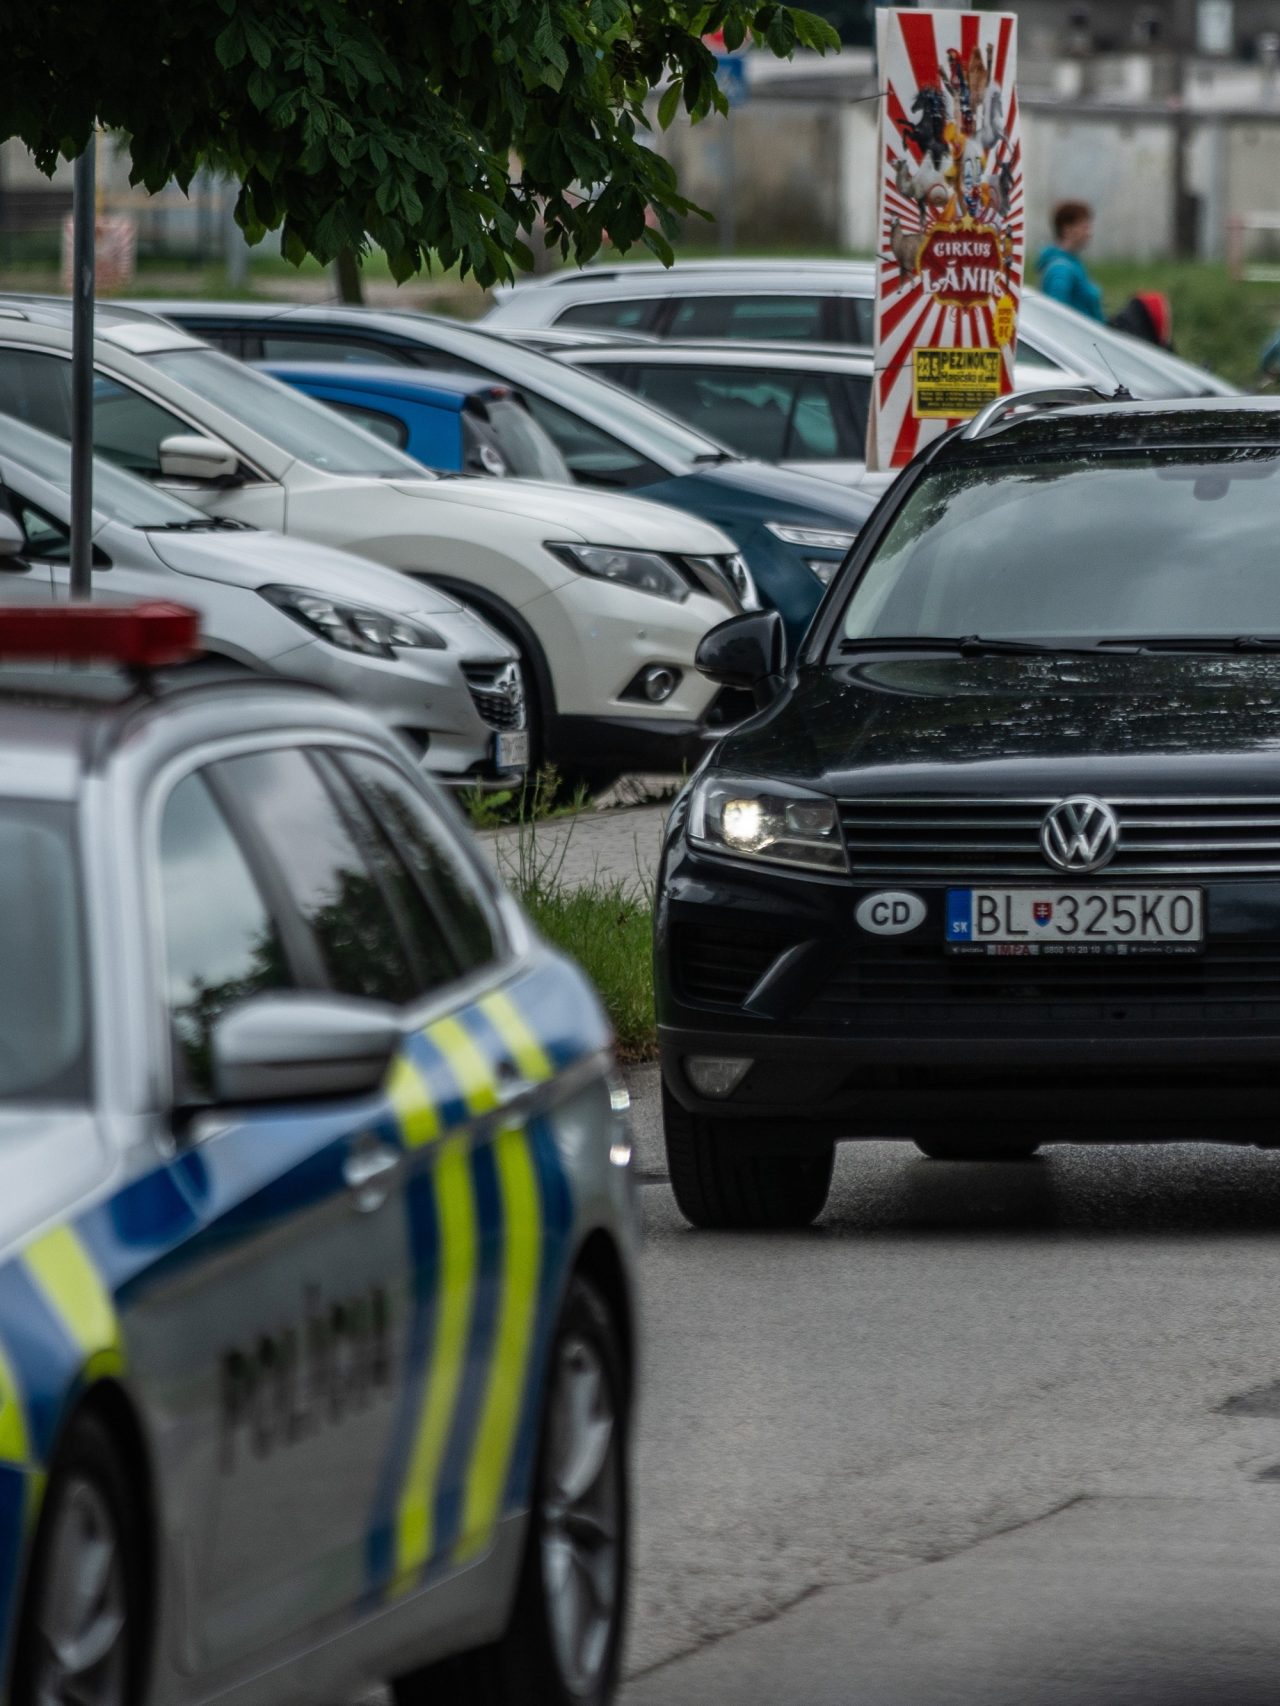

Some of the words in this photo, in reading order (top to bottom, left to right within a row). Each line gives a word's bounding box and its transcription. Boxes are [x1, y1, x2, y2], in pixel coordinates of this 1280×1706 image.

[933, 242, 991, 257] CIRKUS
[922, 260, 1004, 297] LÁNIK
[941, 352, 985, 370] PEZINOK
[870, 901, 910, 926] CD
[952, 921, 969, 934] SK
[976, 895, 1029, 936] BL
